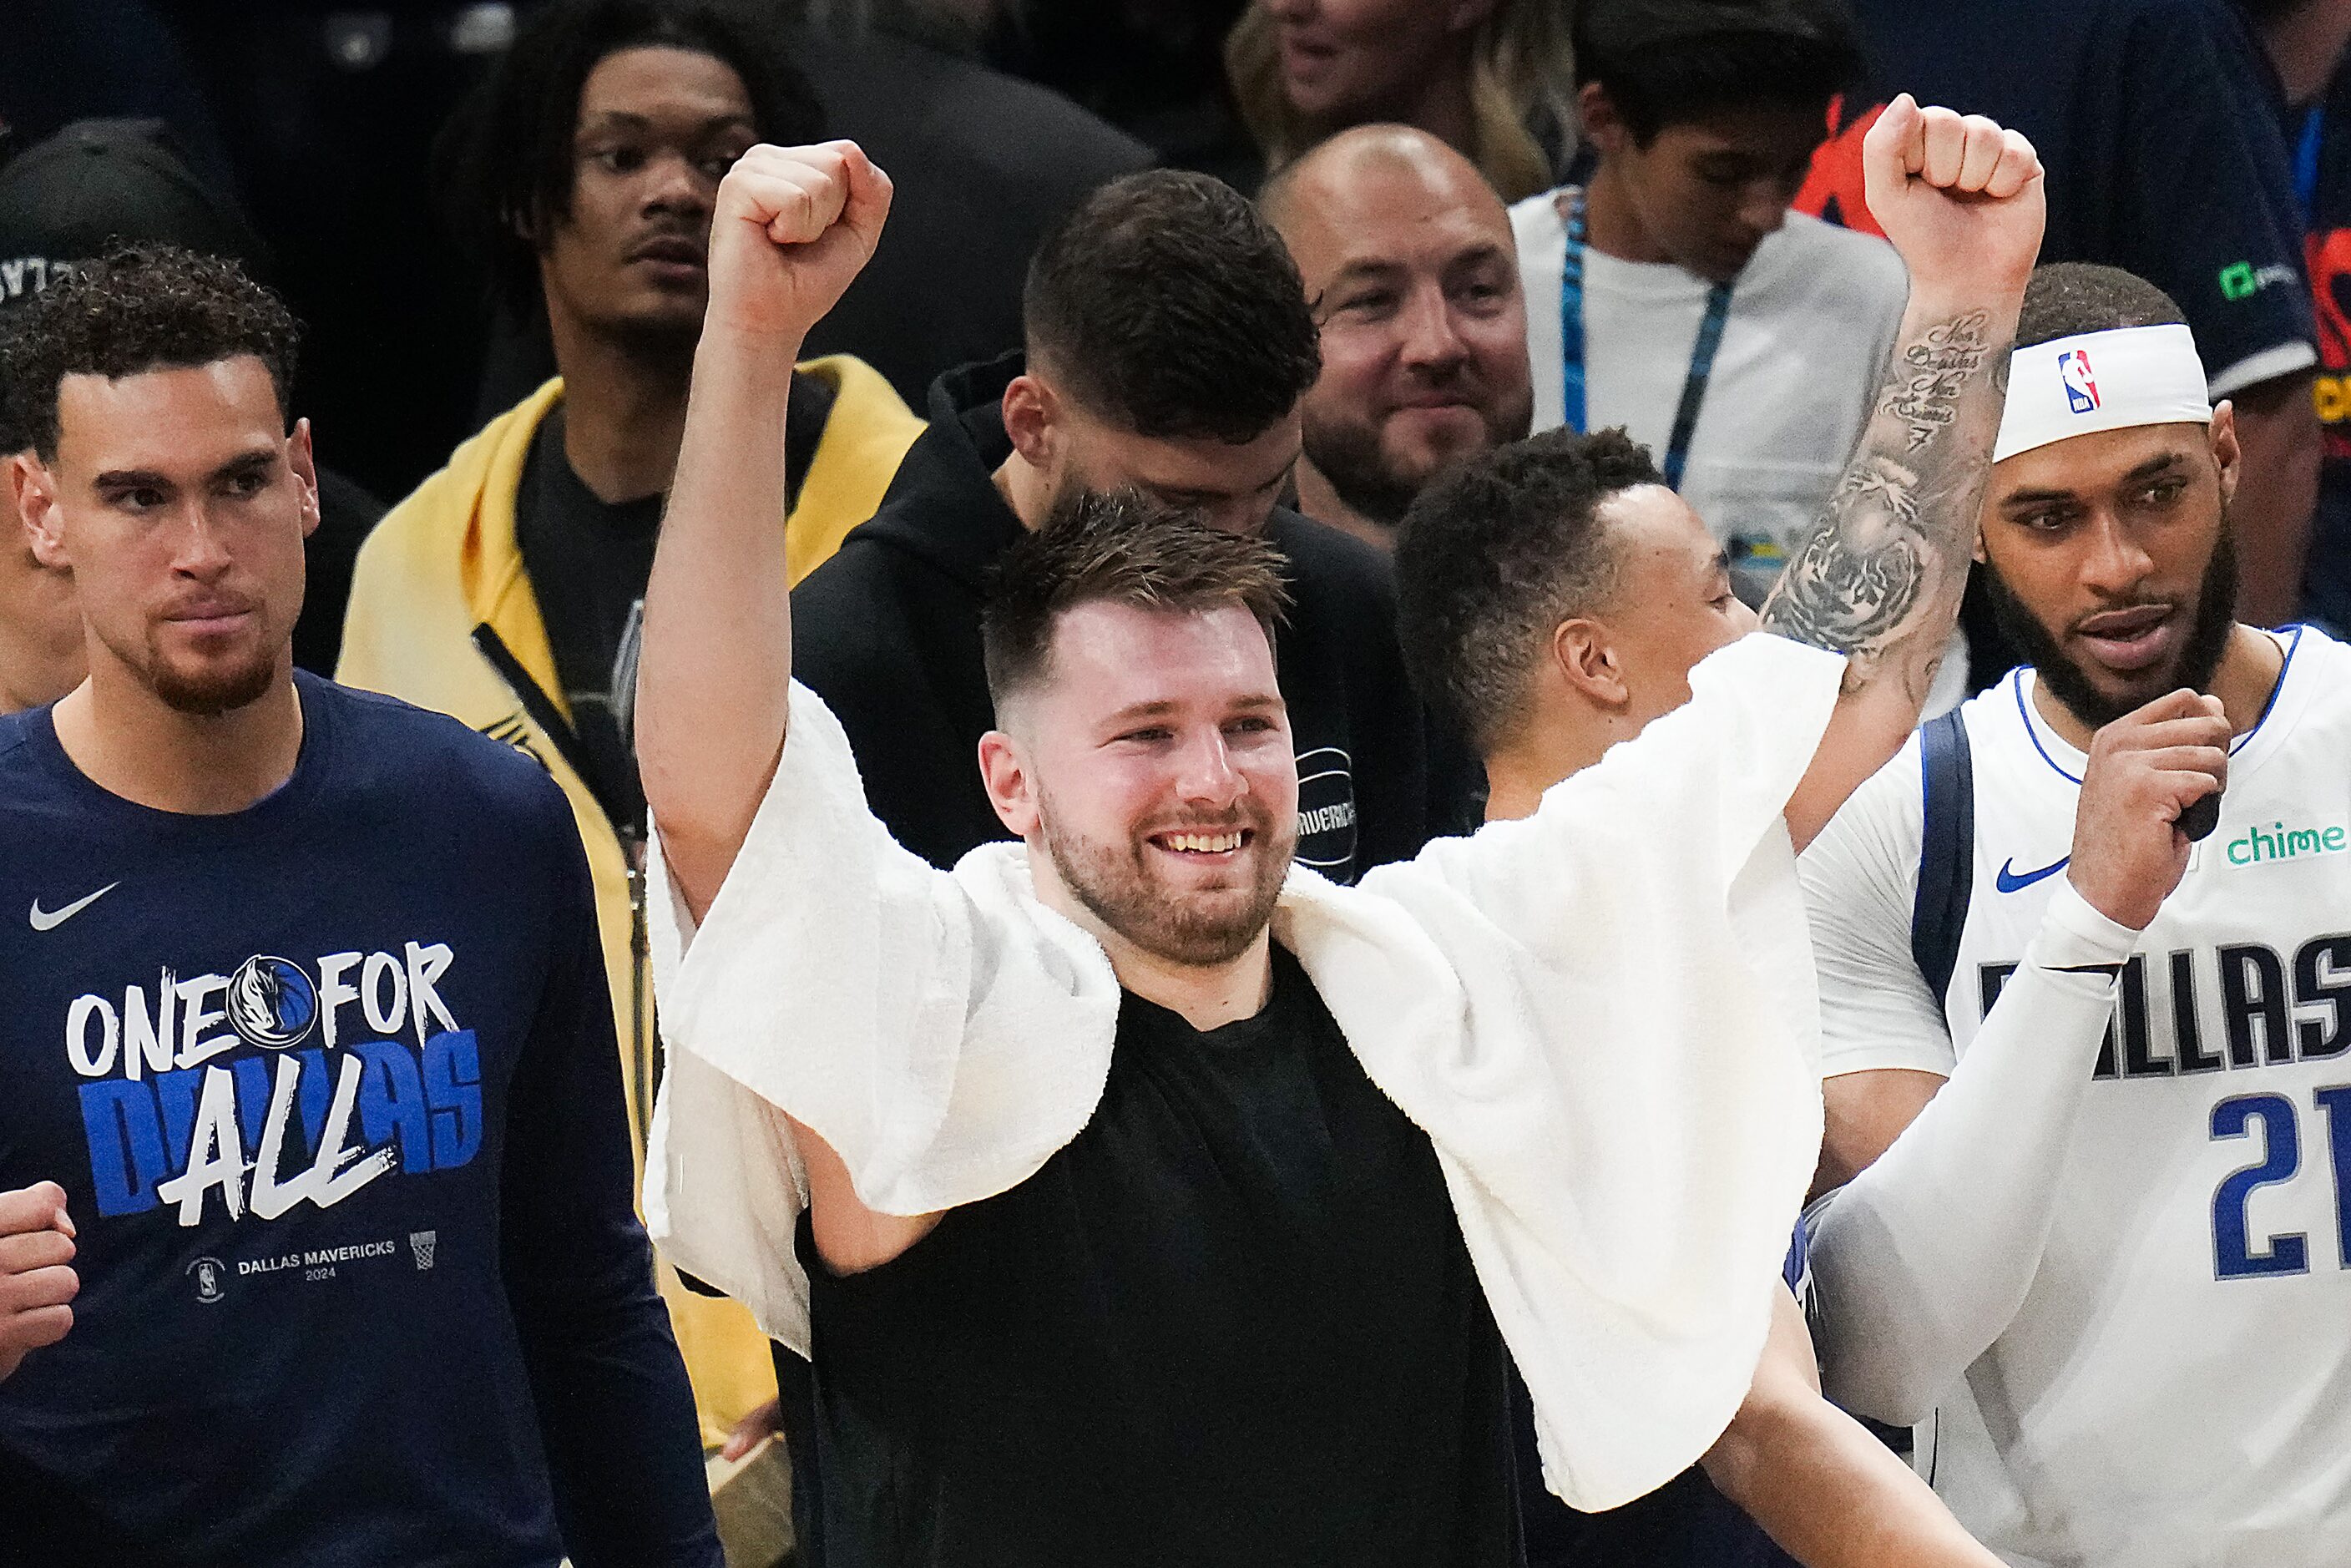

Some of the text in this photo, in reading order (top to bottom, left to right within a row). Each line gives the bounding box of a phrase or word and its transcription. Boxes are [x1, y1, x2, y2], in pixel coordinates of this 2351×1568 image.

[2227, 821, 2348, 866] chime
[65, 940, 461, 1081] ONE FOR
[157, 1053, 397, 1227] ALL
[2208, 1083, 2351, 1282] 21
[238, 1253, 301, 1275] DALLAS
[304, 1240, 396, 1266] MAVERICKS
[305, 1267, 336, 1282] 2024
